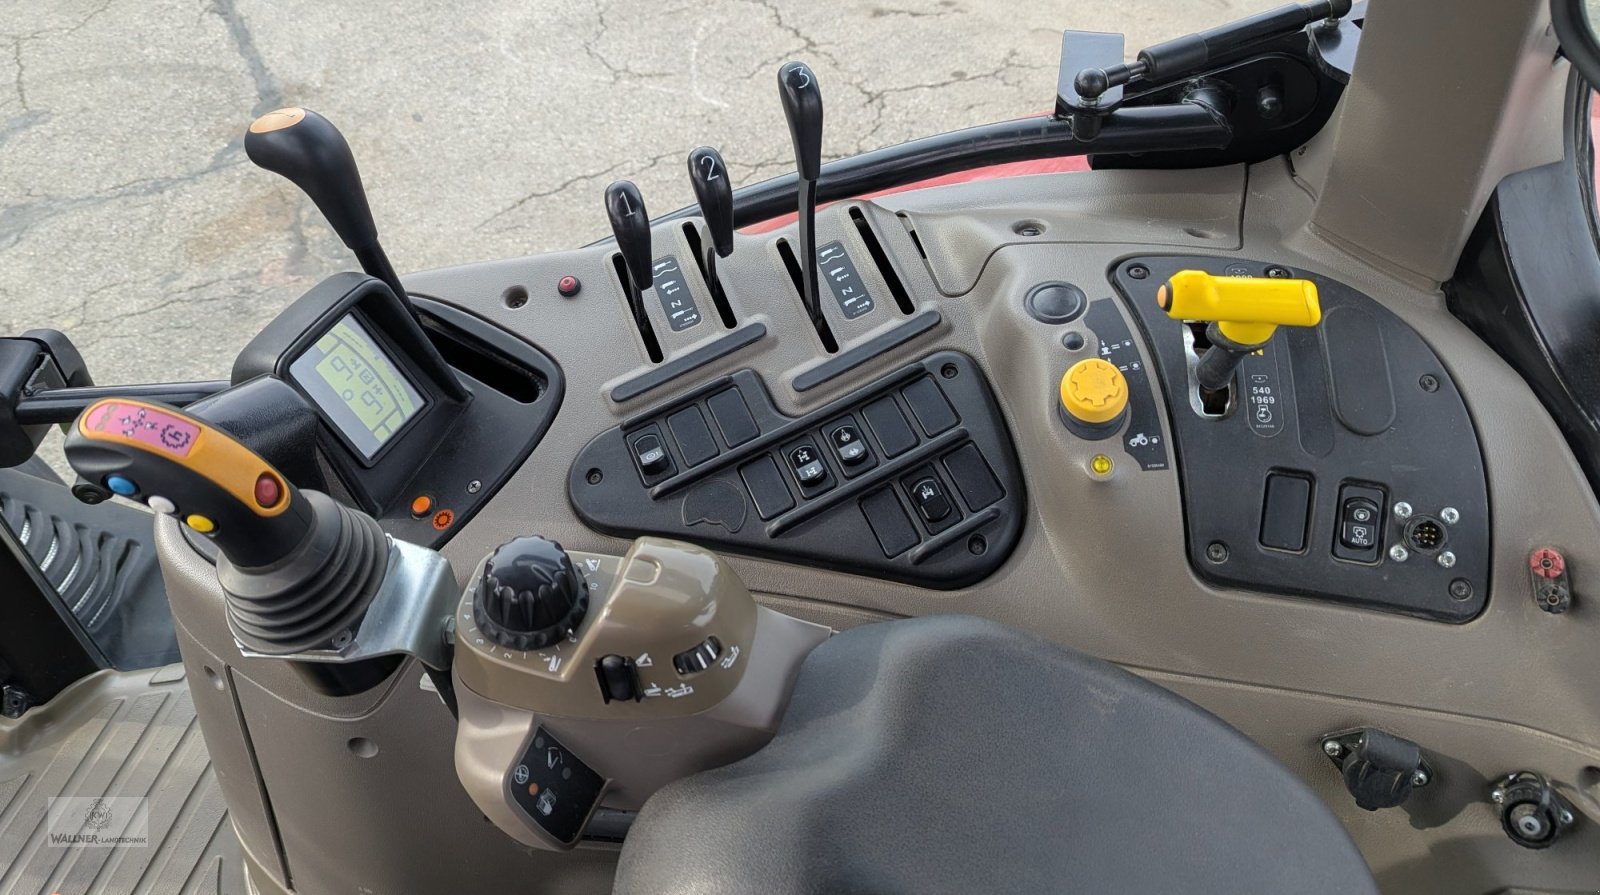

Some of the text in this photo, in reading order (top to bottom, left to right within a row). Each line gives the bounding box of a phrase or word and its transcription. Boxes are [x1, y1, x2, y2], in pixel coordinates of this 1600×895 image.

[789, 67, 810, 89] 3
[700, 156, 720, 181] 2
[619, 191, 636, 217] 1
[1252, 386, 1271, 395] 540
[1250, 396, 1275, 404] 1969
[1351, 537, 1368, 545] AUTO
